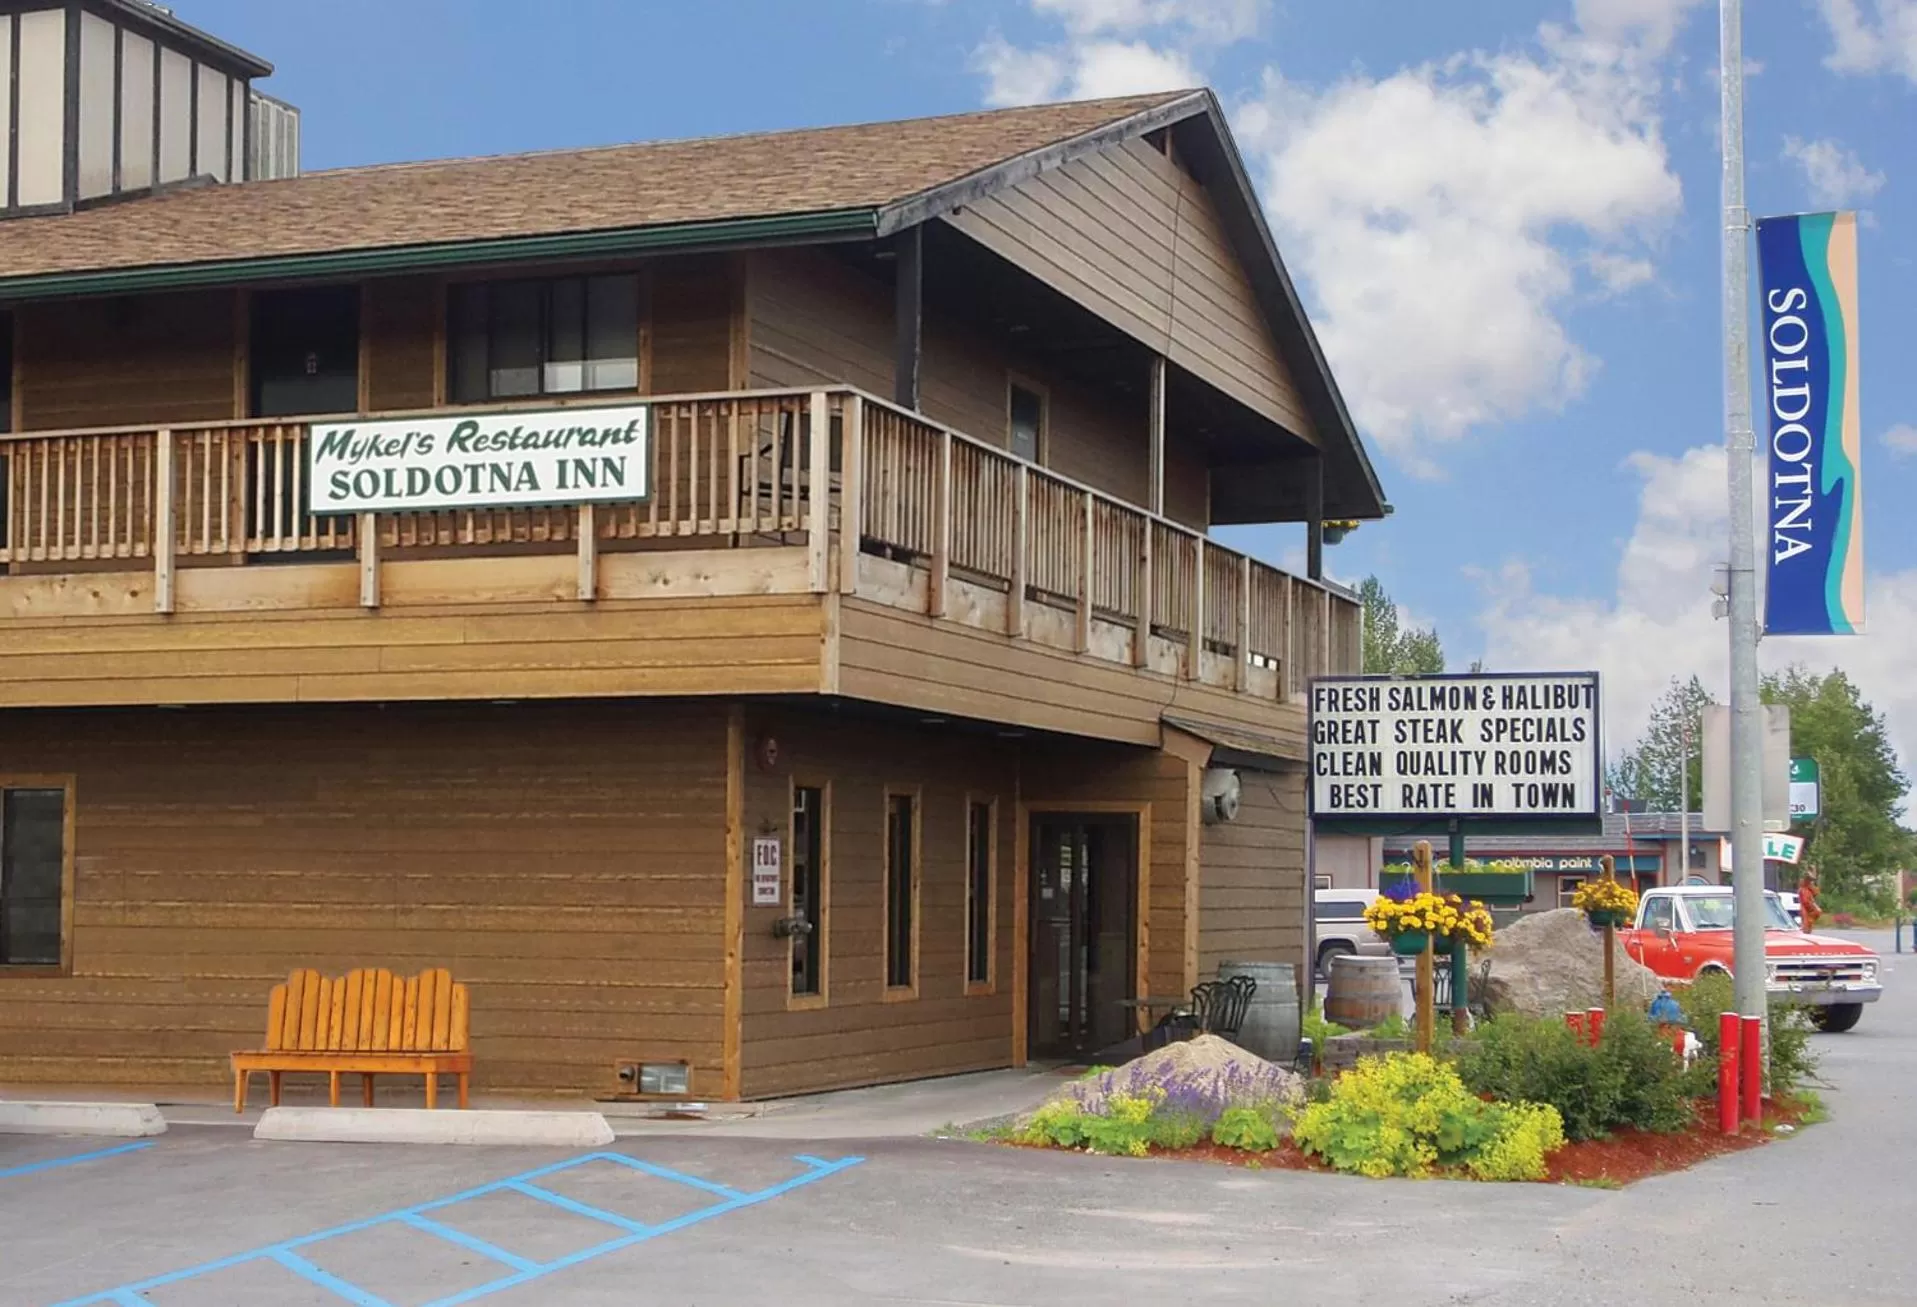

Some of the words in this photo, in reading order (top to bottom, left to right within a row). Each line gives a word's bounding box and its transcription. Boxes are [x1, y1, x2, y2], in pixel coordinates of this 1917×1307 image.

[1768, 288, 1813, 565] SOLDOTNA
[315, 428, 435, 465] Mykel's
[446, 420, 640, 453] Restaurant
[328, 460, 541, 501] SOLDOTNA
[555, 457, 627, 489] INN
[1314, 686, 1381, 713] FRESH
[1387, 684, 1478, 713] SALMON
[1482, 684, 1496, 710] &
[1502, 683, 1595, 711] HALIBUT
[1313, 719, 1380, 745] GREAT
[1394, 719, 1463, 744] STEAK
[1480, 717, 1586, 743] SPECIALS
[1315, 751, 1382, 777] CLEAN
[1396, 750, 1487, 777] QUALITY
[1494, 750, 1572, 776] ROOMS
[1330, 784, 1383, 809] BEST
[1402, 784, 1456, 809] RATE
[1472, 783, 1494, 809] IN
[1512, 783, 1576, 809] TOWN
[1559, 856, 1593, 870] paint
